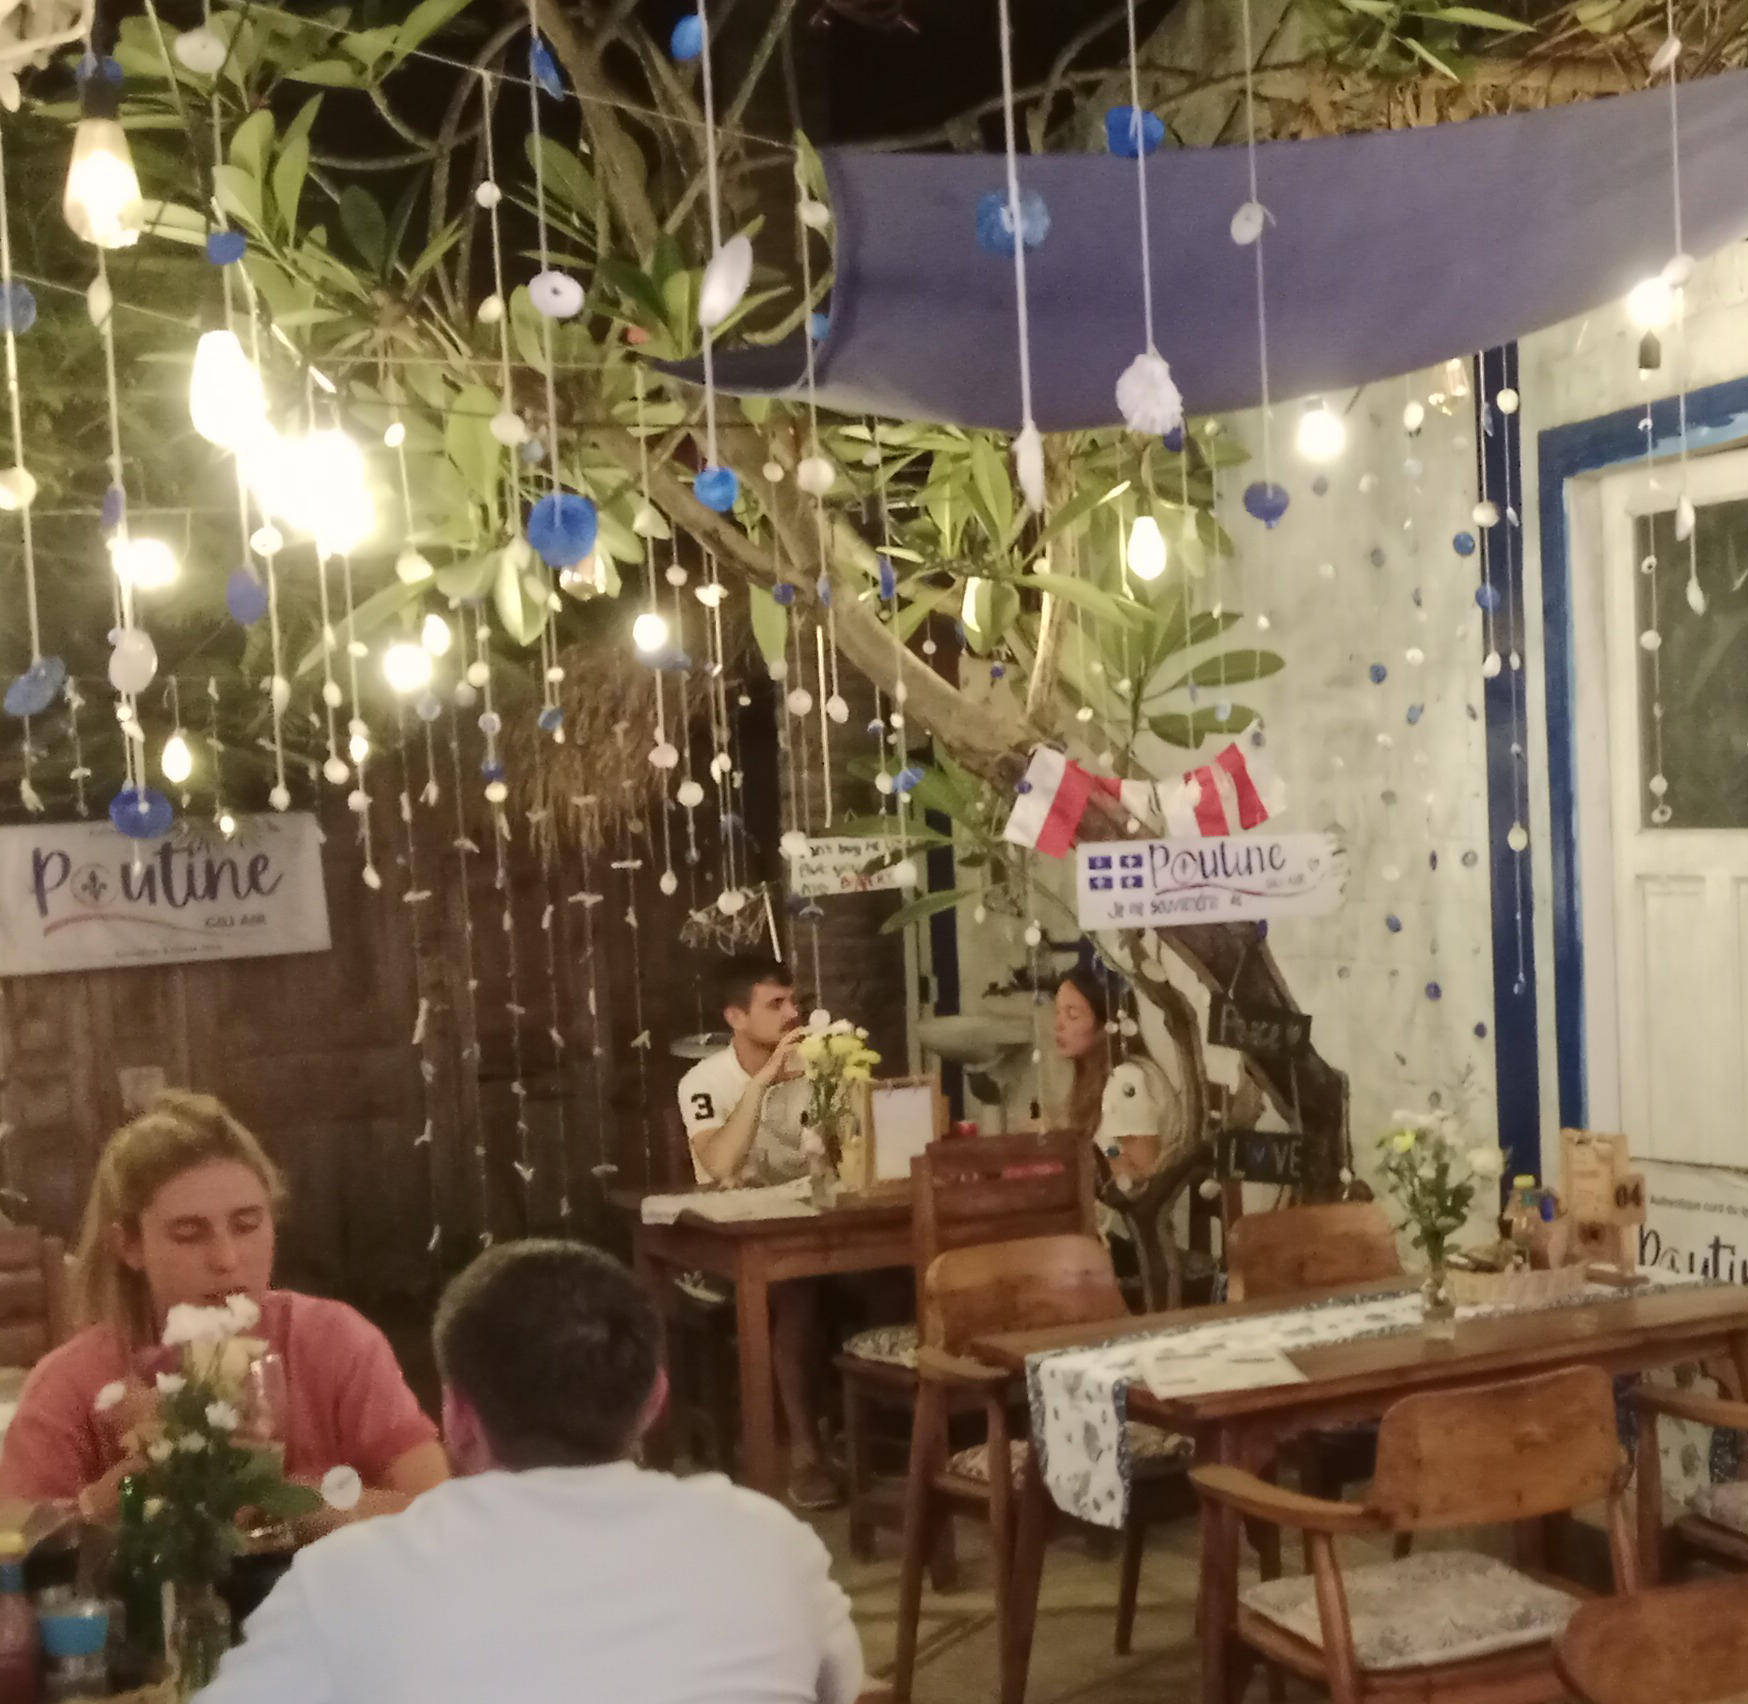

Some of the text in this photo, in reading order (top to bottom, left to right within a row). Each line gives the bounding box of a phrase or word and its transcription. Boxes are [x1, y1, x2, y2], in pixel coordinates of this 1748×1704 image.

[32, 840, 283, 918] Poutine
[1149, 842, 1286, 888] Poutine
[691, 1092, 715, 1120] 3
[1614, 1181, 1643, 1209] 04
